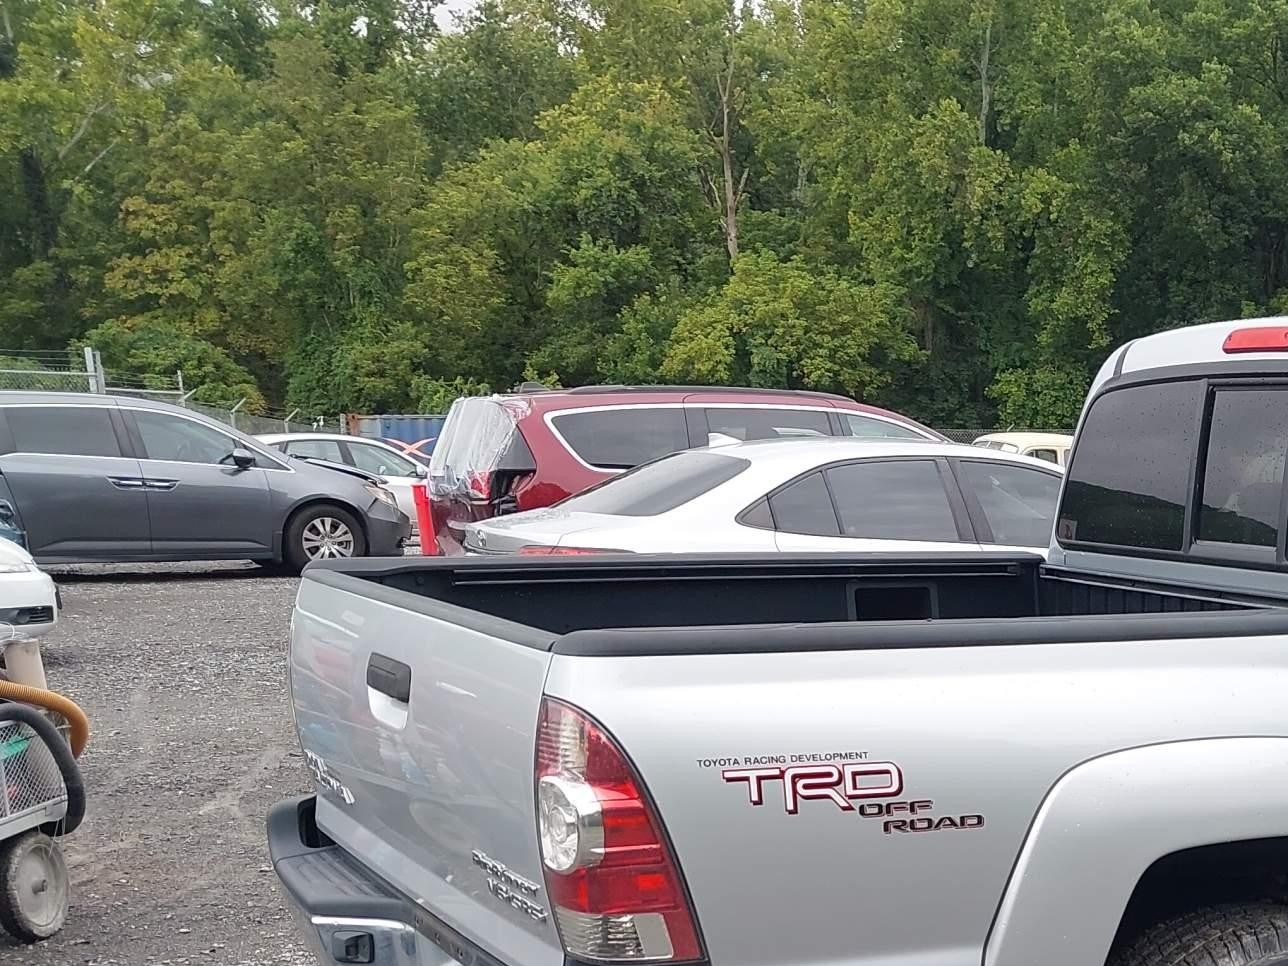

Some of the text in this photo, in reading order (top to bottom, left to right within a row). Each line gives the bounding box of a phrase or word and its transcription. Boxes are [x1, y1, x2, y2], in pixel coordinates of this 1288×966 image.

[696, 751, 869, 768] TOYOTA RACING DEVELOPMENT
[722, 761, 903, 815] TRD
[858, 799, 934, 818] OFF
[882, 814, 985, 835] ROAD
